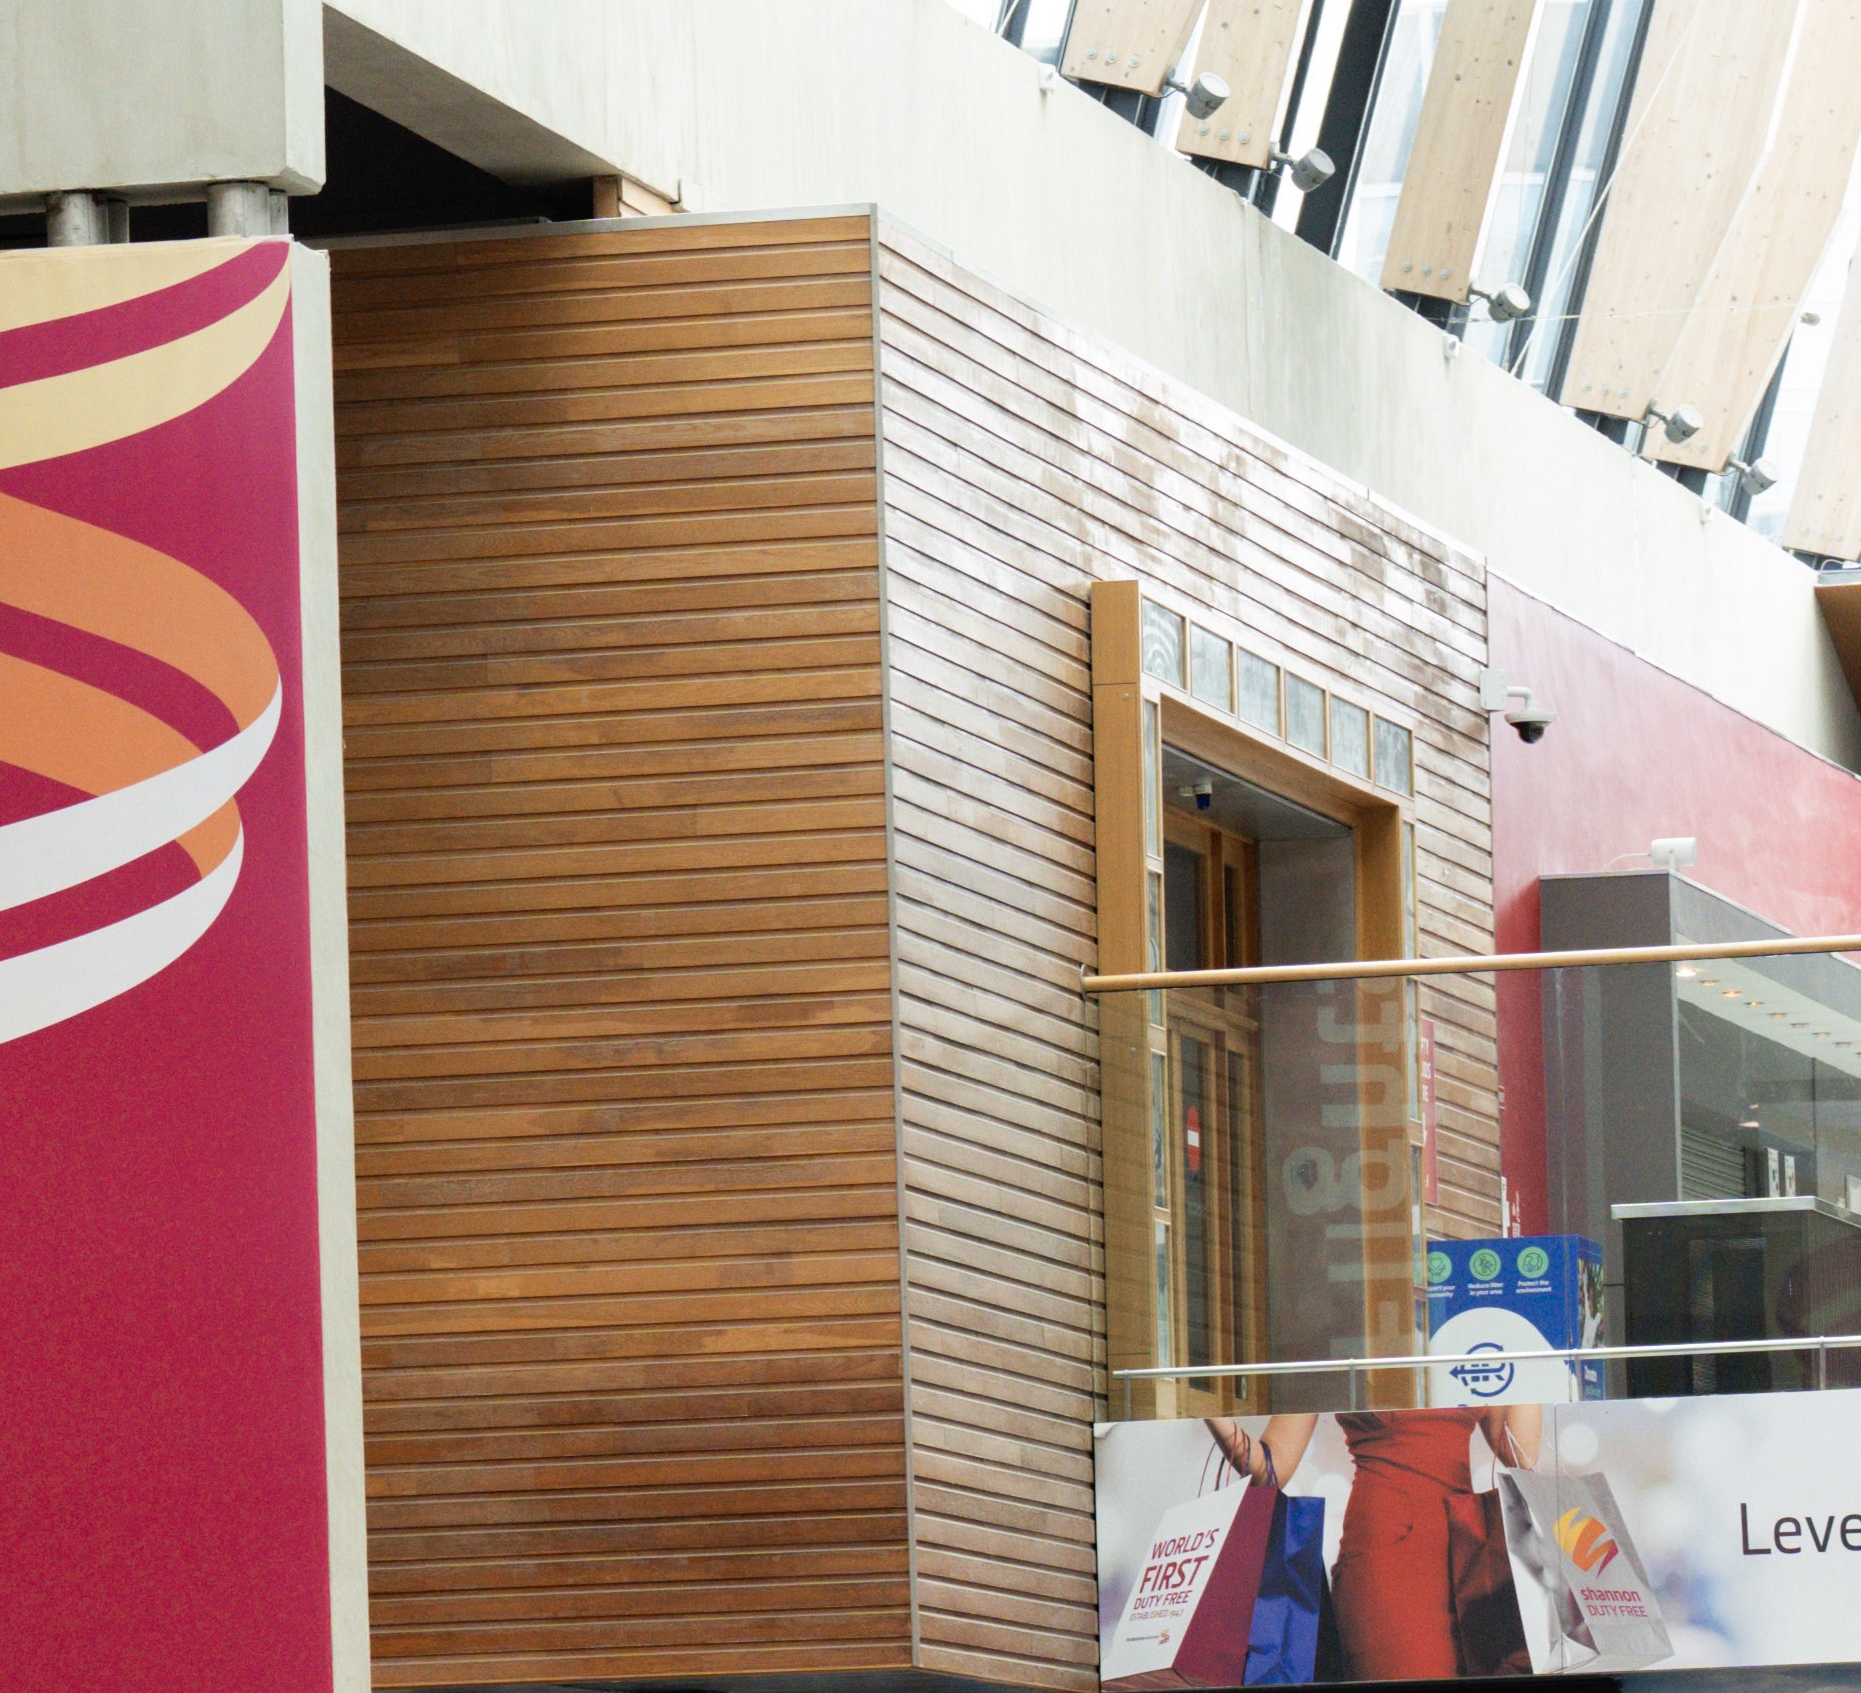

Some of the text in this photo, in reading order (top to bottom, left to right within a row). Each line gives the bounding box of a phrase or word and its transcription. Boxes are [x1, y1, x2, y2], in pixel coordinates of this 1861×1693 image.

[1151, 1528, 1220, 1560] WORLD'S
[1139, 1555, 1209, 1594] FIRST
[1133, 1590, 1193, 1610] DUTY FREE
[1580, 1587, 1643, 1602] shannon
[1587, 1604, 1648, 1618] DUTY FREE
